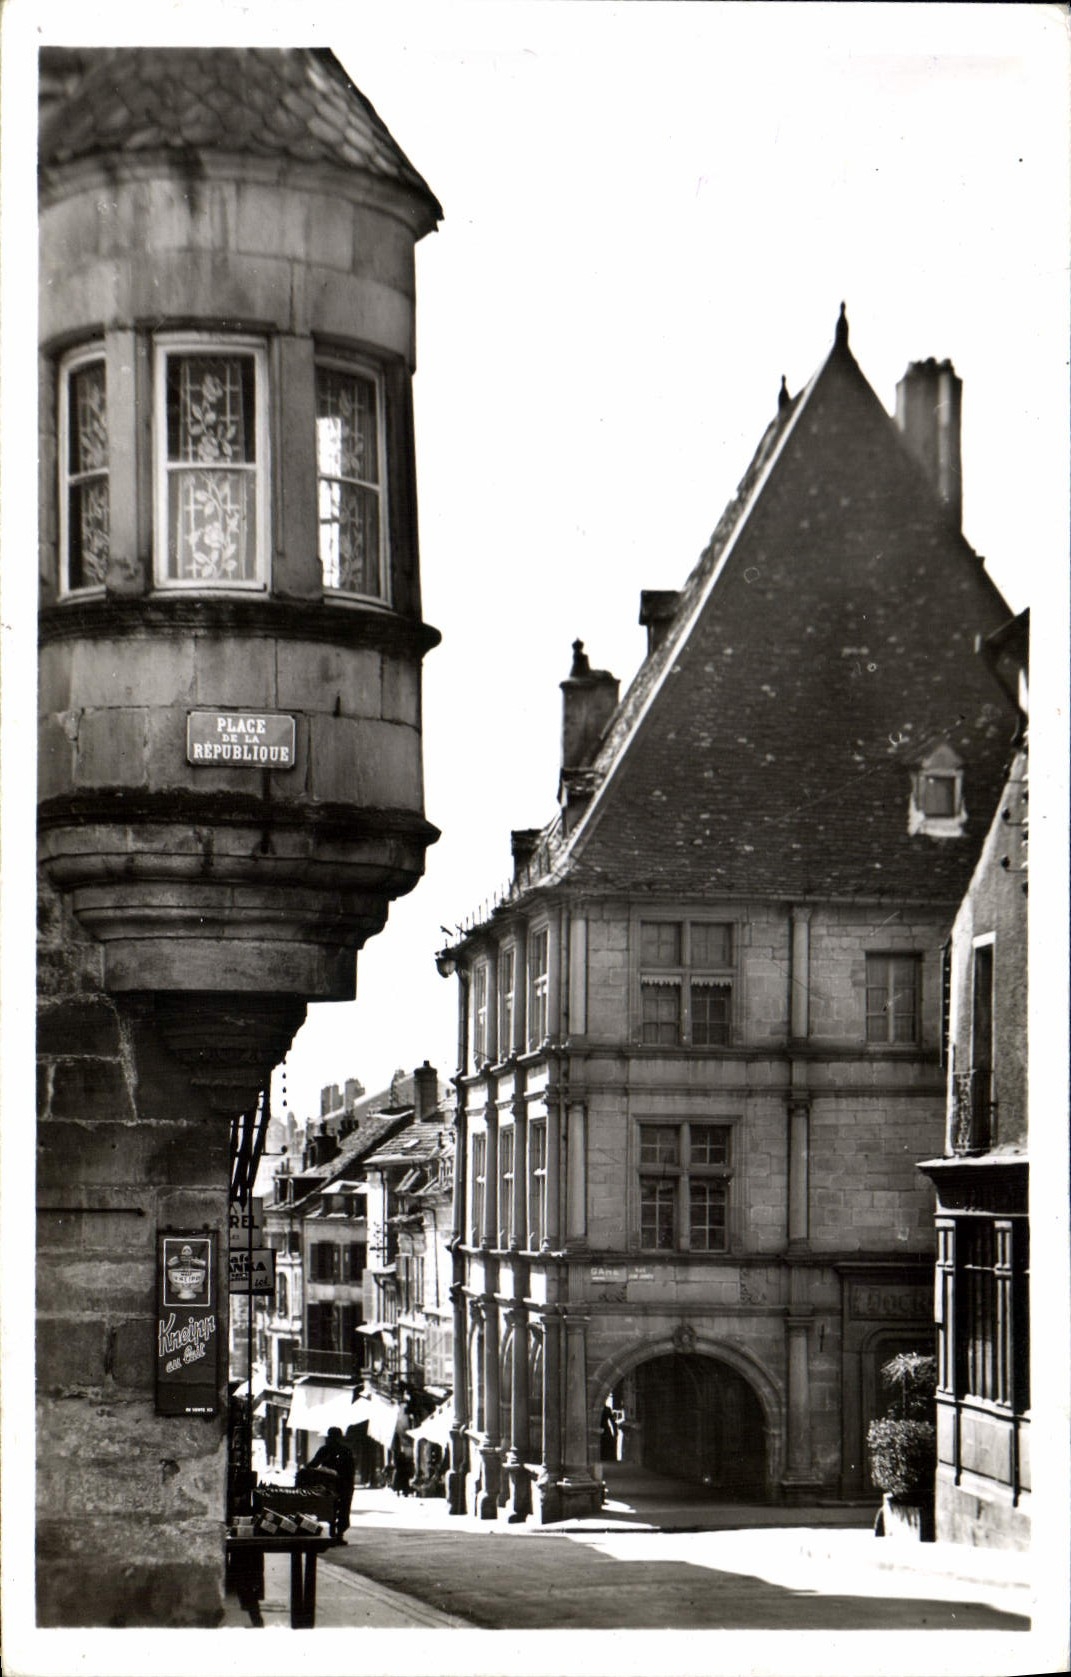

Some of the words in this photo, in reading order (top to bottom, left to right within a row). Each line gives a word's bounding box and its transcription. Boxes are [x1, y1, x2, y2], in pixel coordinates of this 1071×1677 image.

[217, 717, 267, 735] PLACE
[222, 733, 238, 743] DE
[245, 734, 260, 744] LA
[193, 741, 289, 763] RÉPUBLIQUE
[158, 1312, 216, 1357] Kneipp
